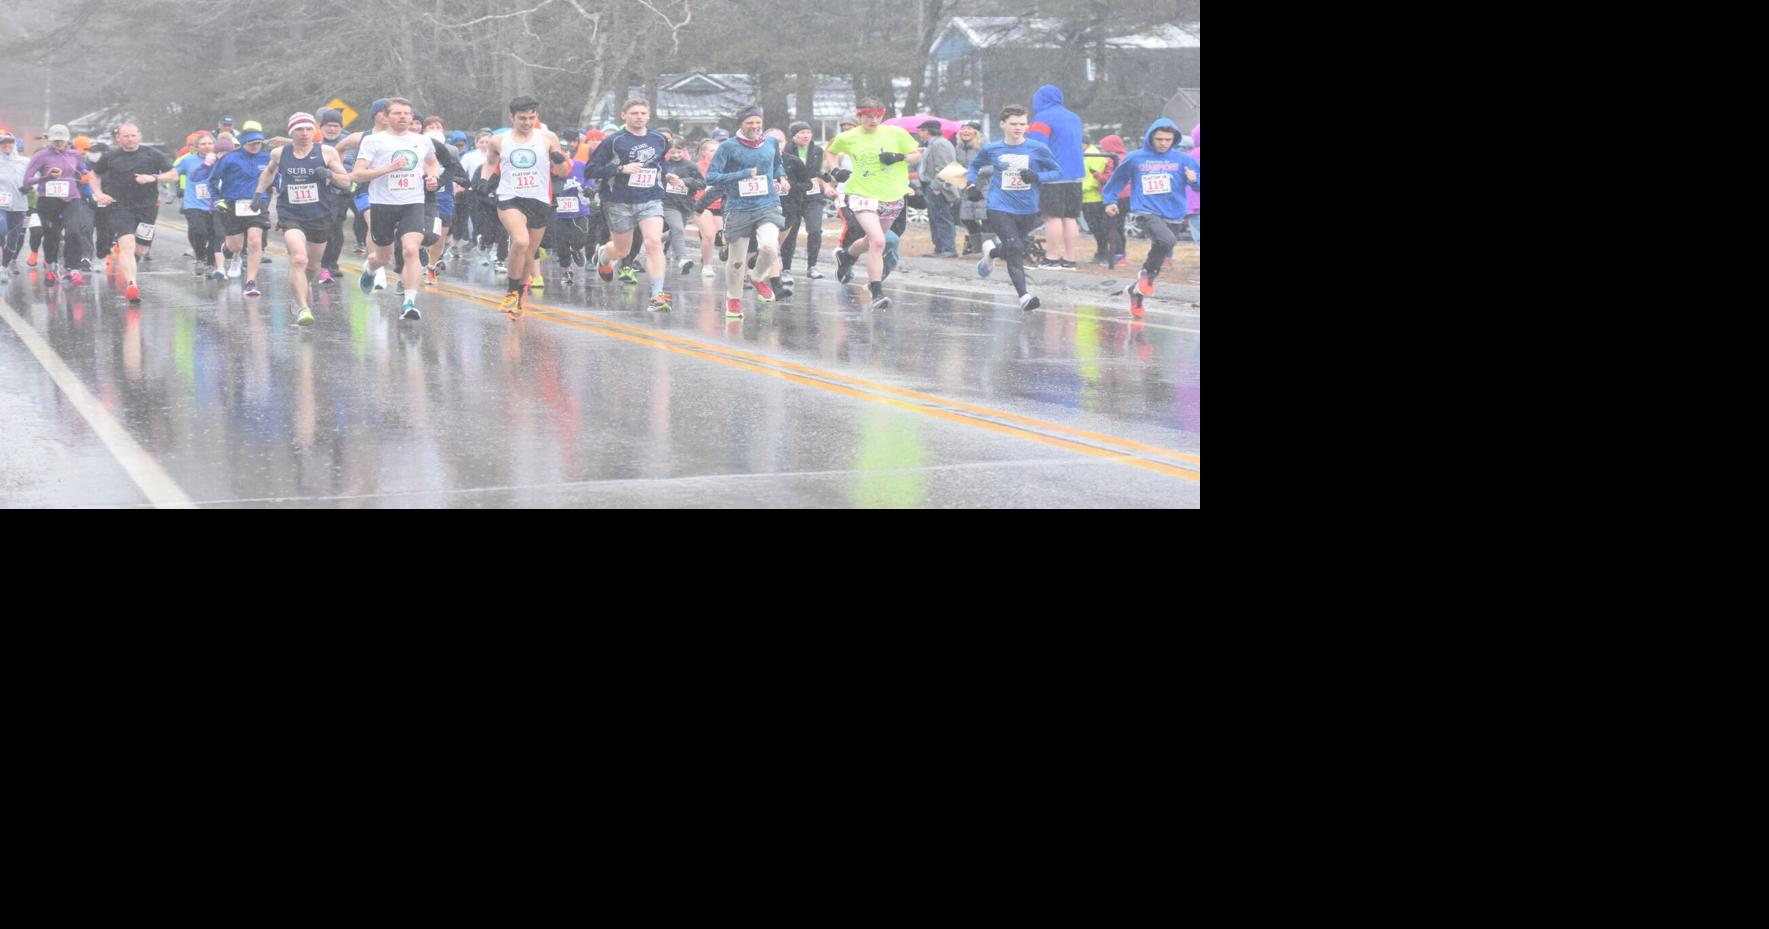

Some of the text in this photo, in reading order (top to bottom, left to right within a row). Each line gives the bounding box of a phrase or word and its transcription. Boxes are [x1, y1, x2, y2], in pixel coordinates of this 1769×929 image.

[287, 167, 306, 175] SUB
[398, 178, 408, 187] 48
[518, 176, 534, 186] 112
[748, 181, 759, 191] 53
[1011, 177, 1022, 186] 22
[1147, 180, 1164, 190] 119
[294, 190, 312, 200] 111
